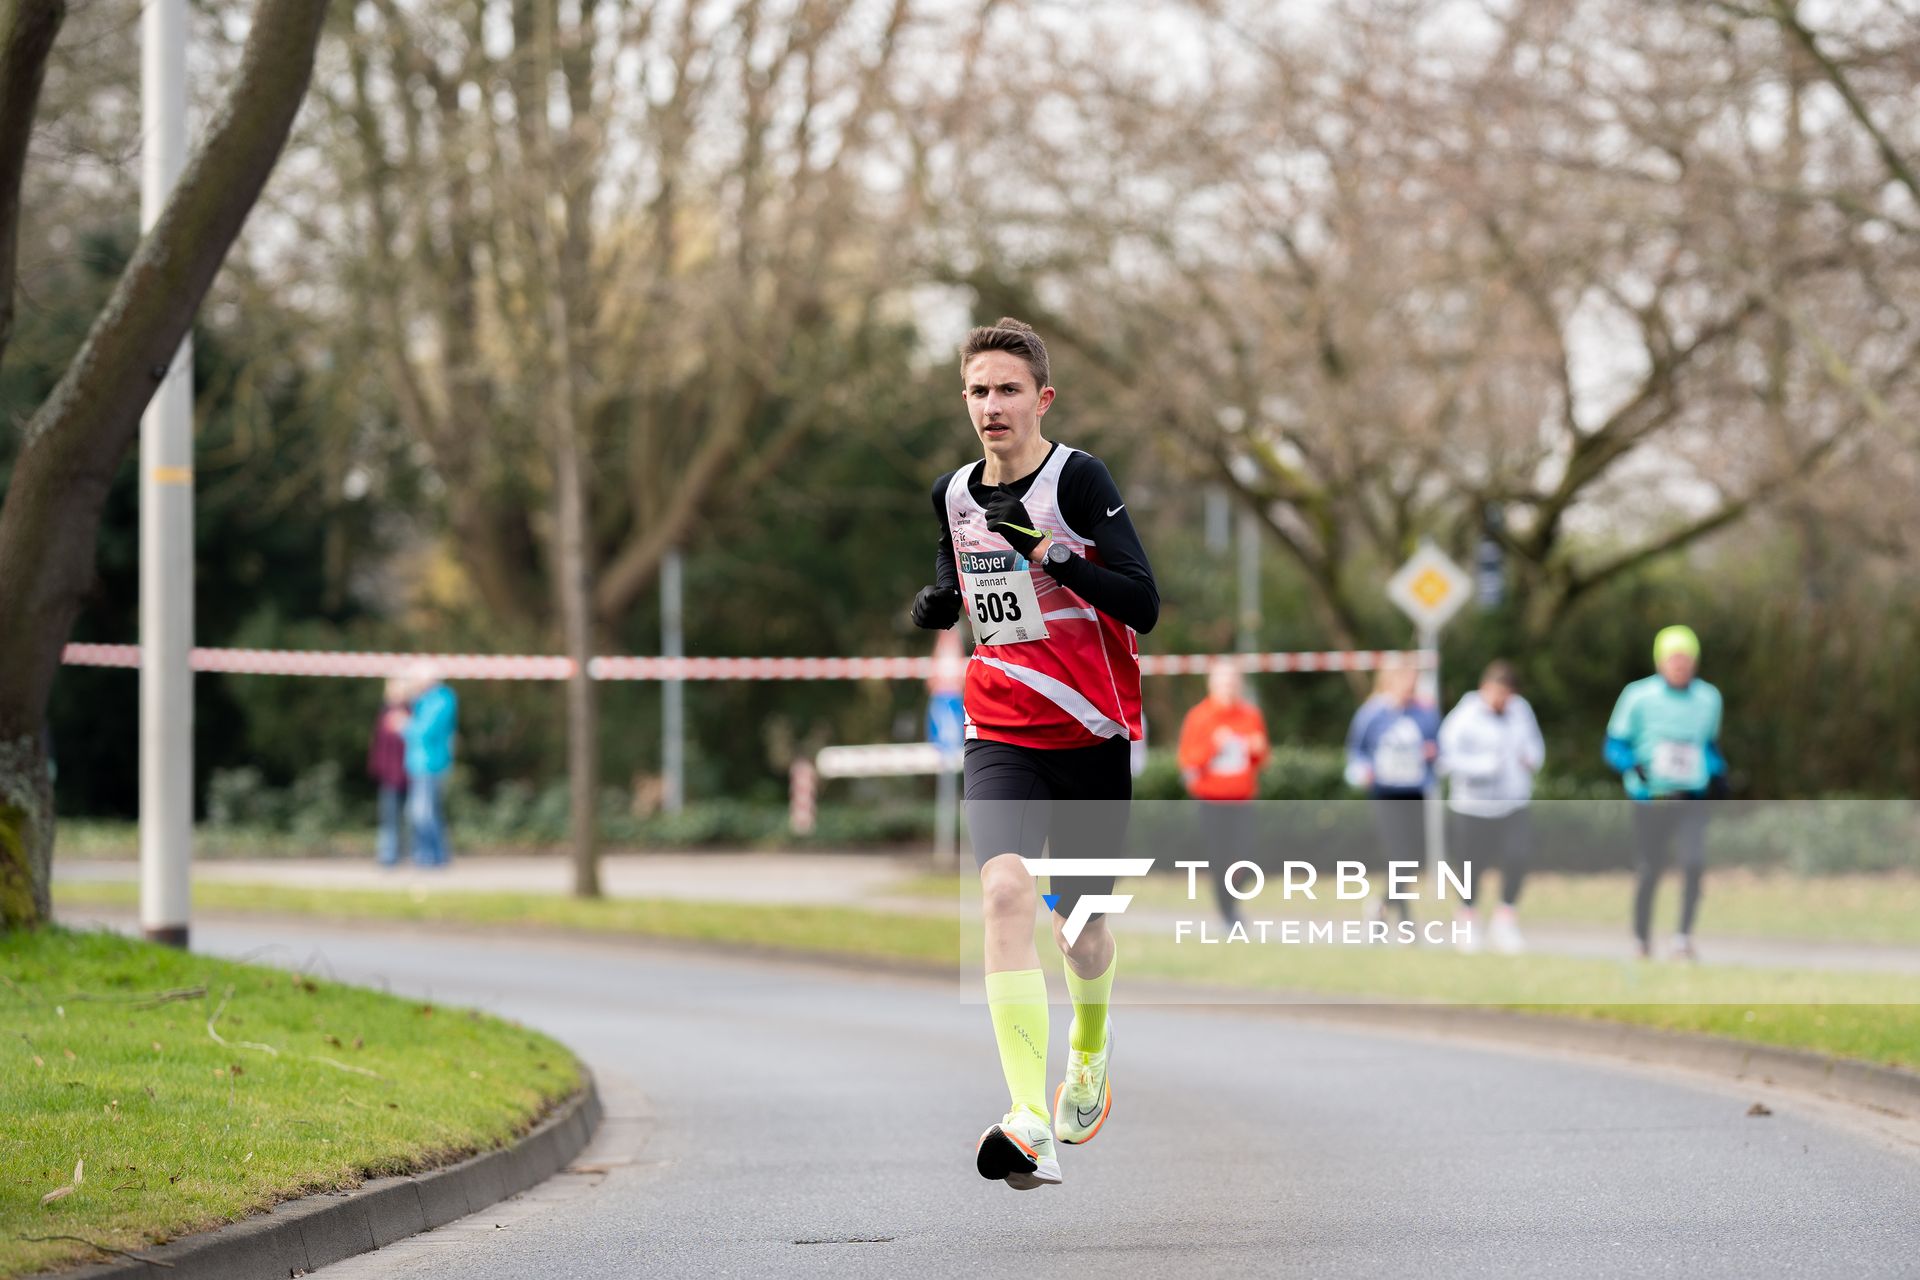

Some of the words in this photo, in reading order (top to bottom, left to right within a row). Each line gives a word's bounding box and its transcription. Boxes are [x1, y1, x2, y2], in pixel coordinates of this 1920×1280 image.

[970, 555, 1006, 573] Bayer
[975, 576, 1007, 587] Lennart
[974, 591, 1022, 623] 503
